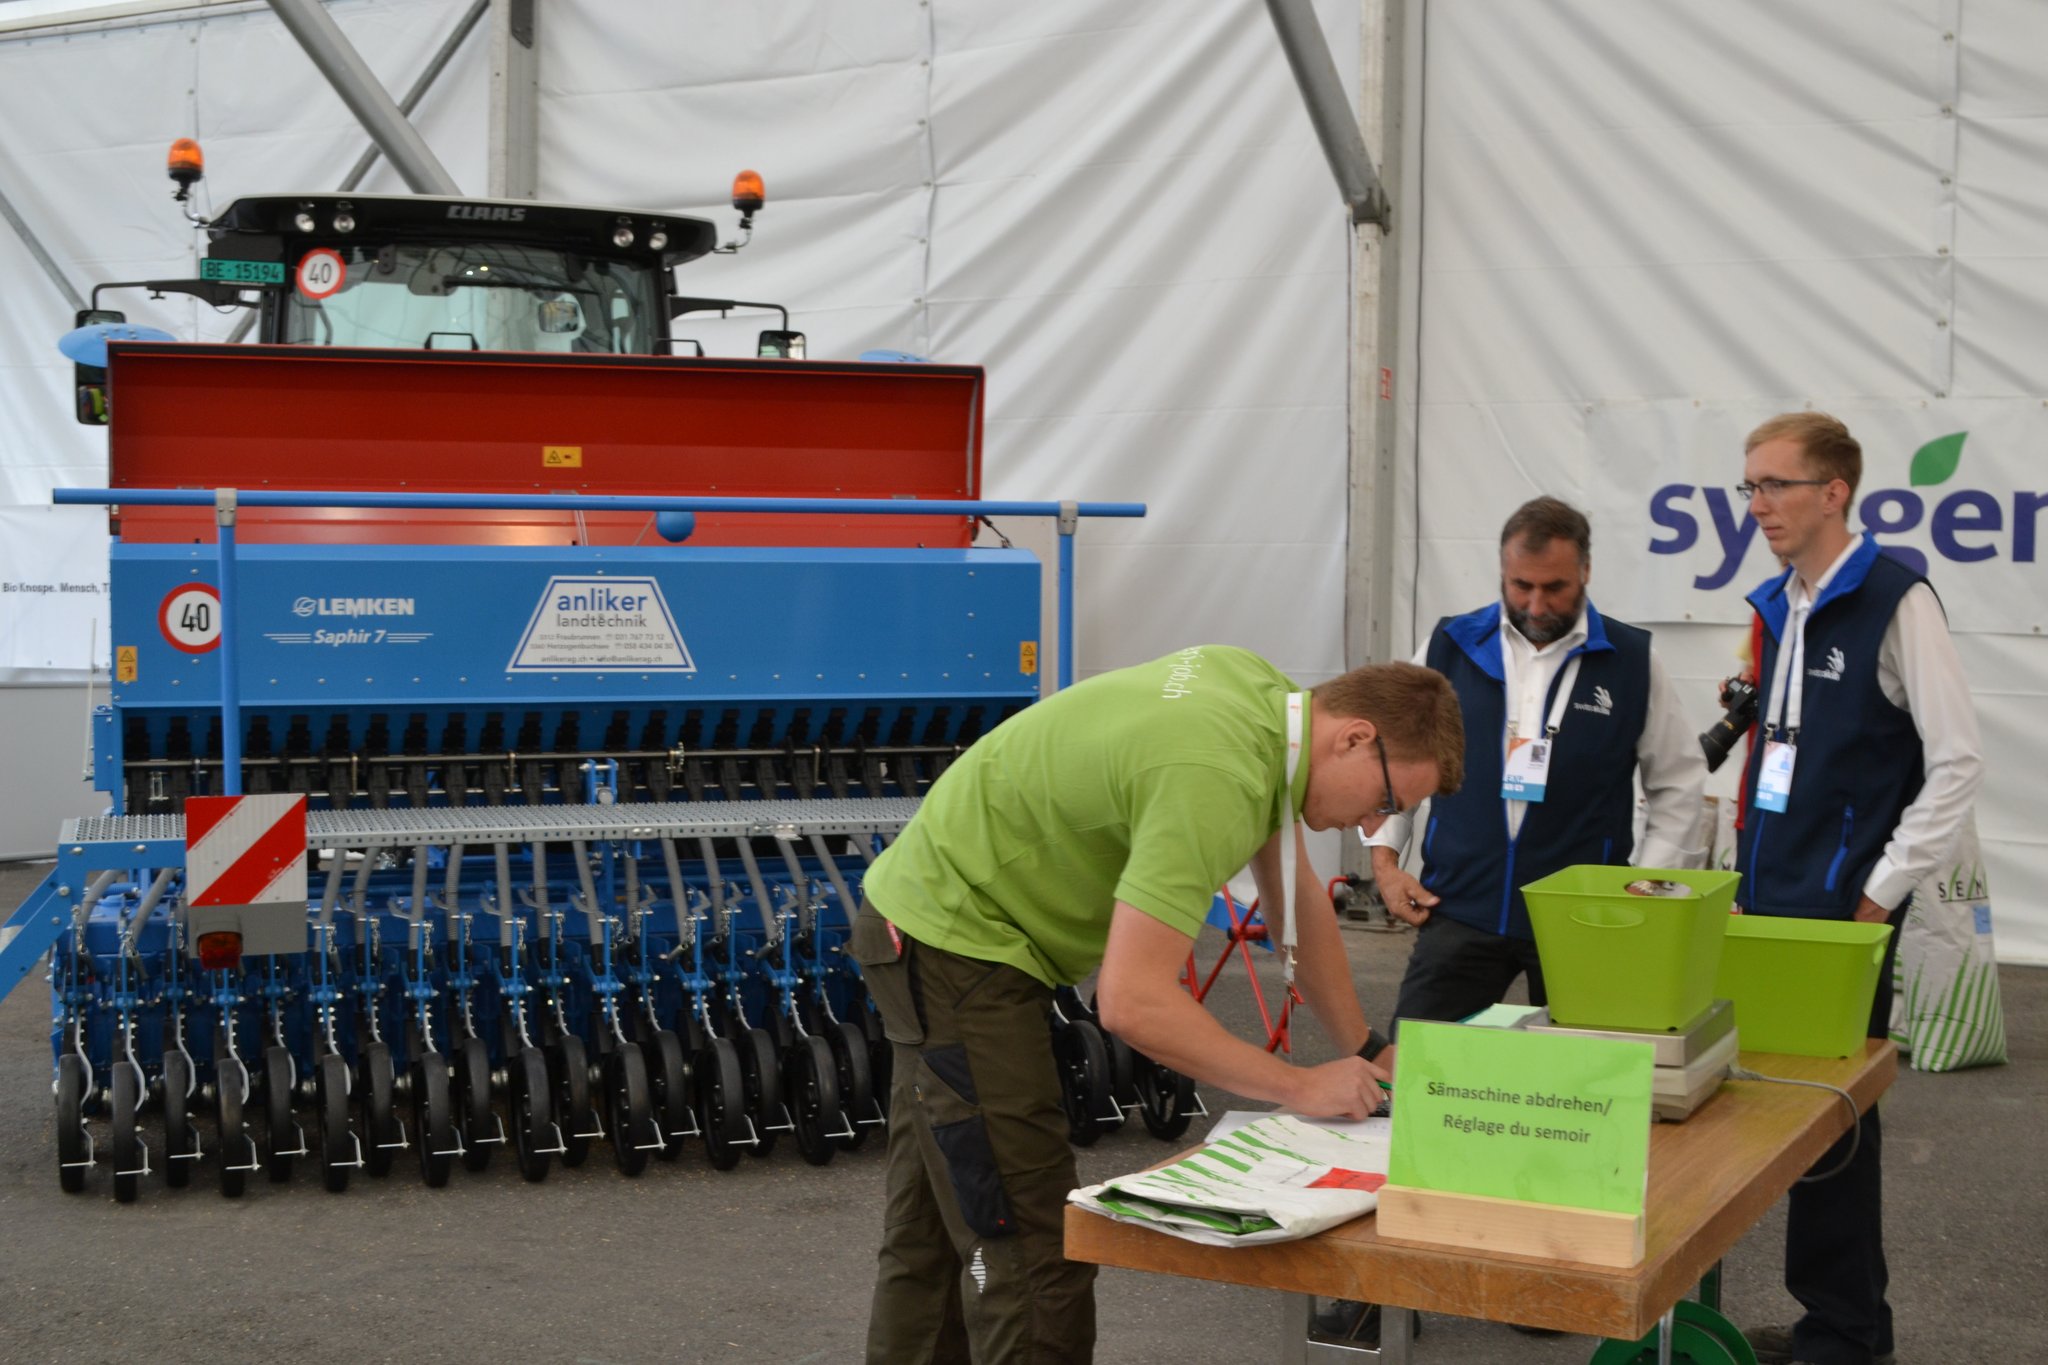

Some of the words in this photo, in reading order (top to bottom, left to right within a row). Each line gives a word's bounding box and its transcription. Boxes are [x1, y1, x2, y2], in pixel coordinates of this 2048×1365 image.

[446, 205, 527, 221] CLAAS
[308, 263, 332, 285] 40
[3, 583, 18, 592] Bio
[20, 583, 57, 595] Knospe.
[60, 583, 100, 595] Mensch,
[318, 598, 415, 616] LEMKEN
[557, 588, 648, 611] anliker
[181, 603, 211, 632] 40
[557, 614, 647, 627] landtechnik
[313, 629, 372, 647] Saphir
[374, 630, 387, 644] 7
[1427, 1081, 1520, 1105] Sämaschine
[1525, 1092, 1613, 1117] abdrehen/
[1443, 1114, 1505, 1136] Réglage
[1510, 1121, 1530, 1138] du
[1535, 1128, 1591, 1144] semoir
